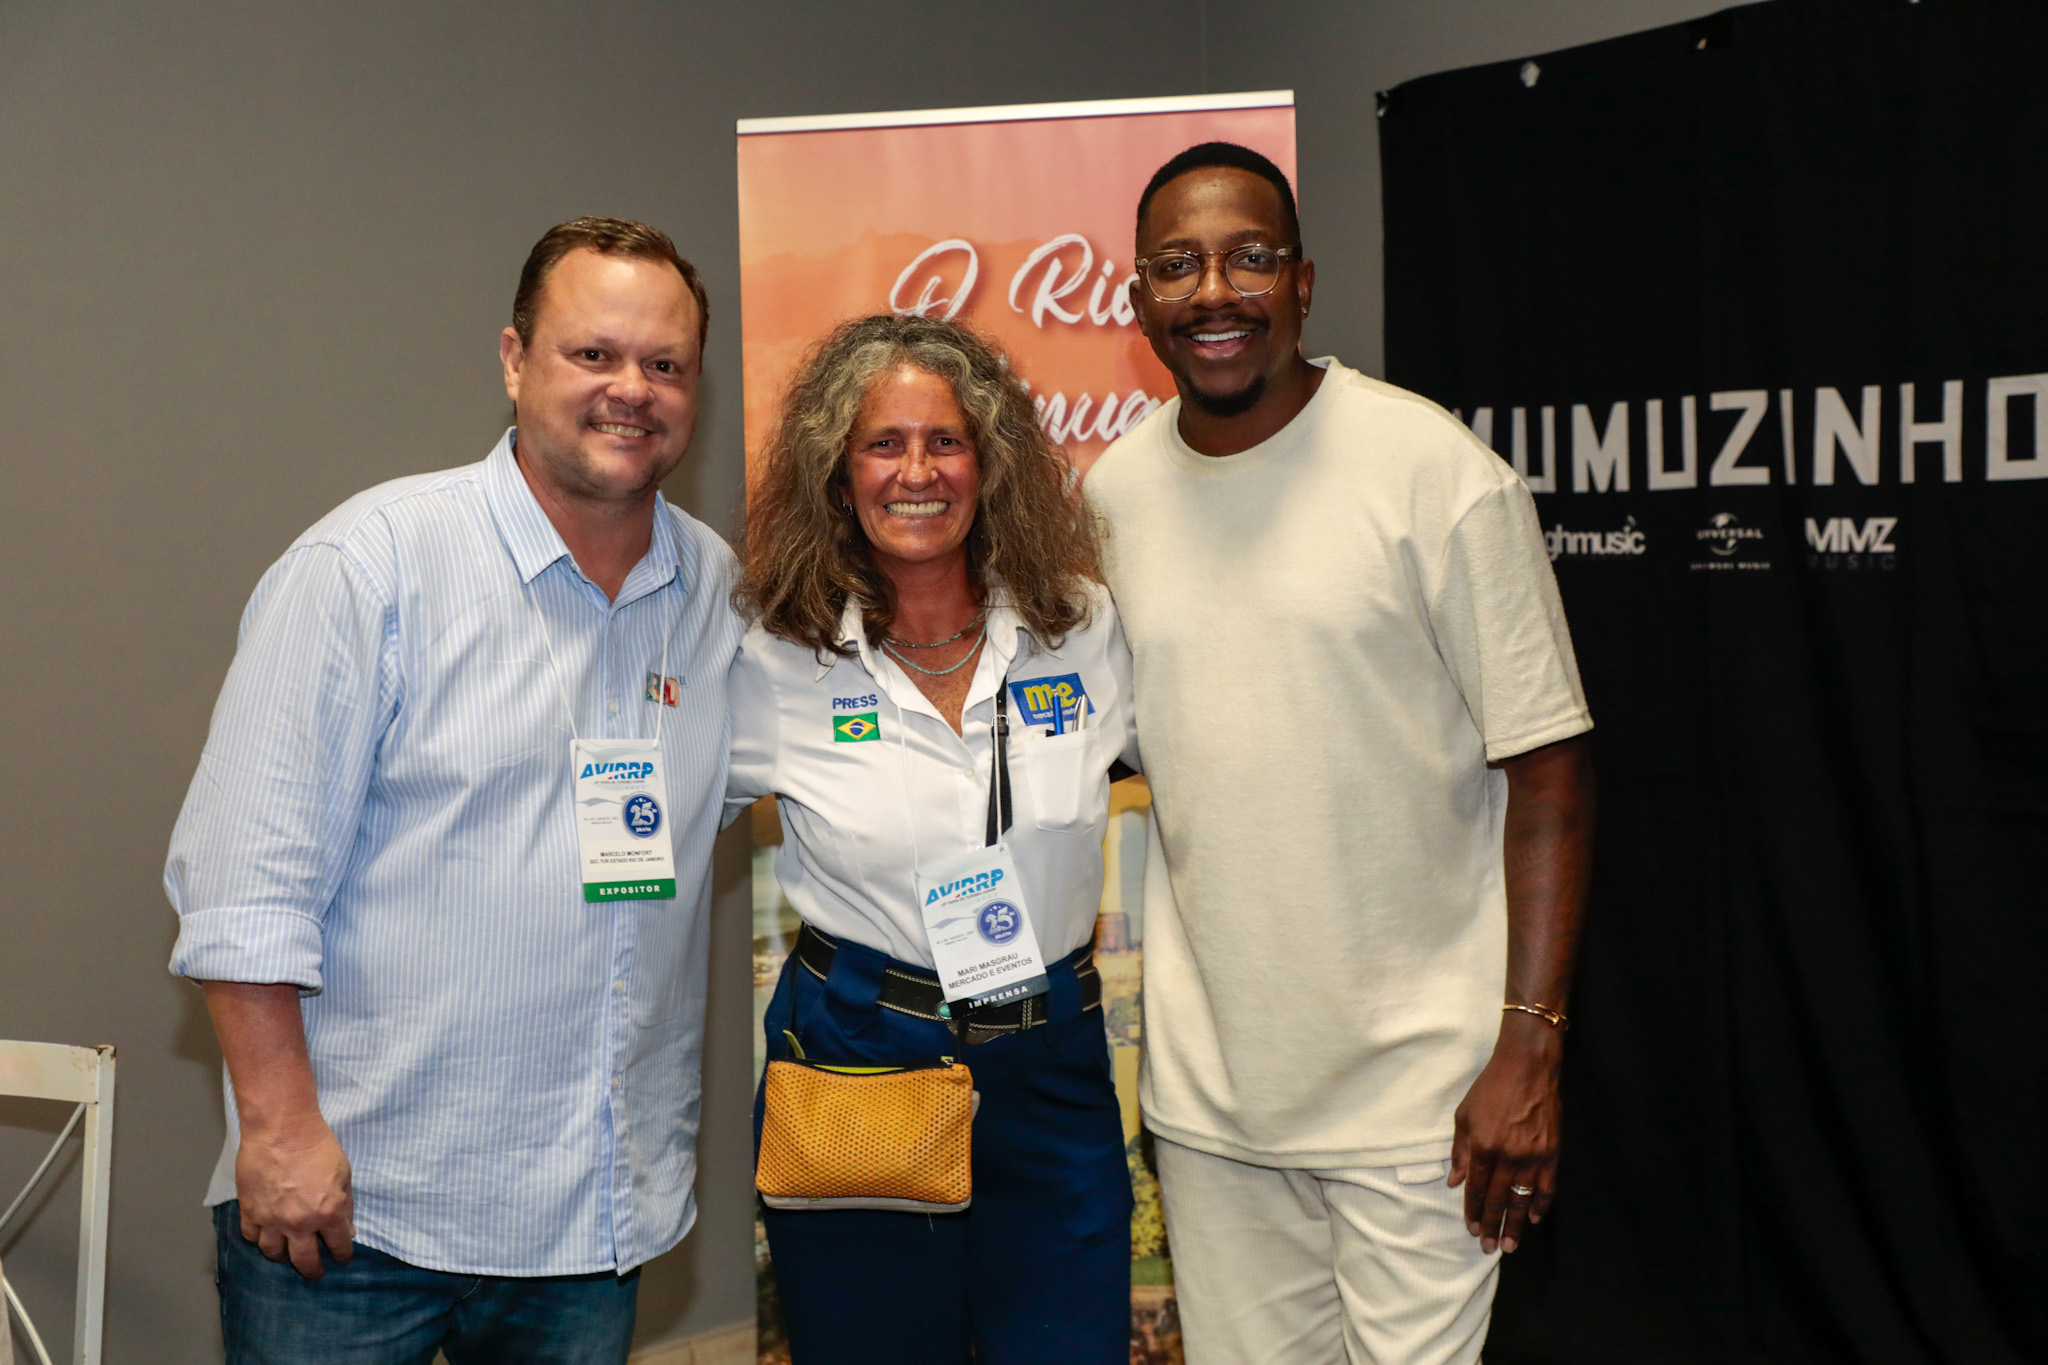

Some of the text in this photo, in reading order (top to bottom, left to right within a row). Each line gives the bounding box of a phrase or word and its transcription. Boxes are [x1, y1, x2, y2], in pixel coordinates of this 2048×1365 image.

[1009, 233, 1138, 327] Rio
[1545, 523, 1646, 561] ghmusic
[1804, 517, 1898, 553] MMZ
[832, 693, 878, 710] PRESS
[579, 762, 654, 780] AVIRRP
[630, 801, 655, 827] 25
[599, 884, 660, 895] EXPOSITOR
[925, 868, 1004, 907] AVIRRP
[985, 906, 1014, 935] 25
[949, 972, 987, 989] MERCADO
[997, 958, 1032, 974] EVENTOS
[958, 953, 1018, 977] MARI MASGRAU
[968, 985, 1029, 1009] IMPRENSA
